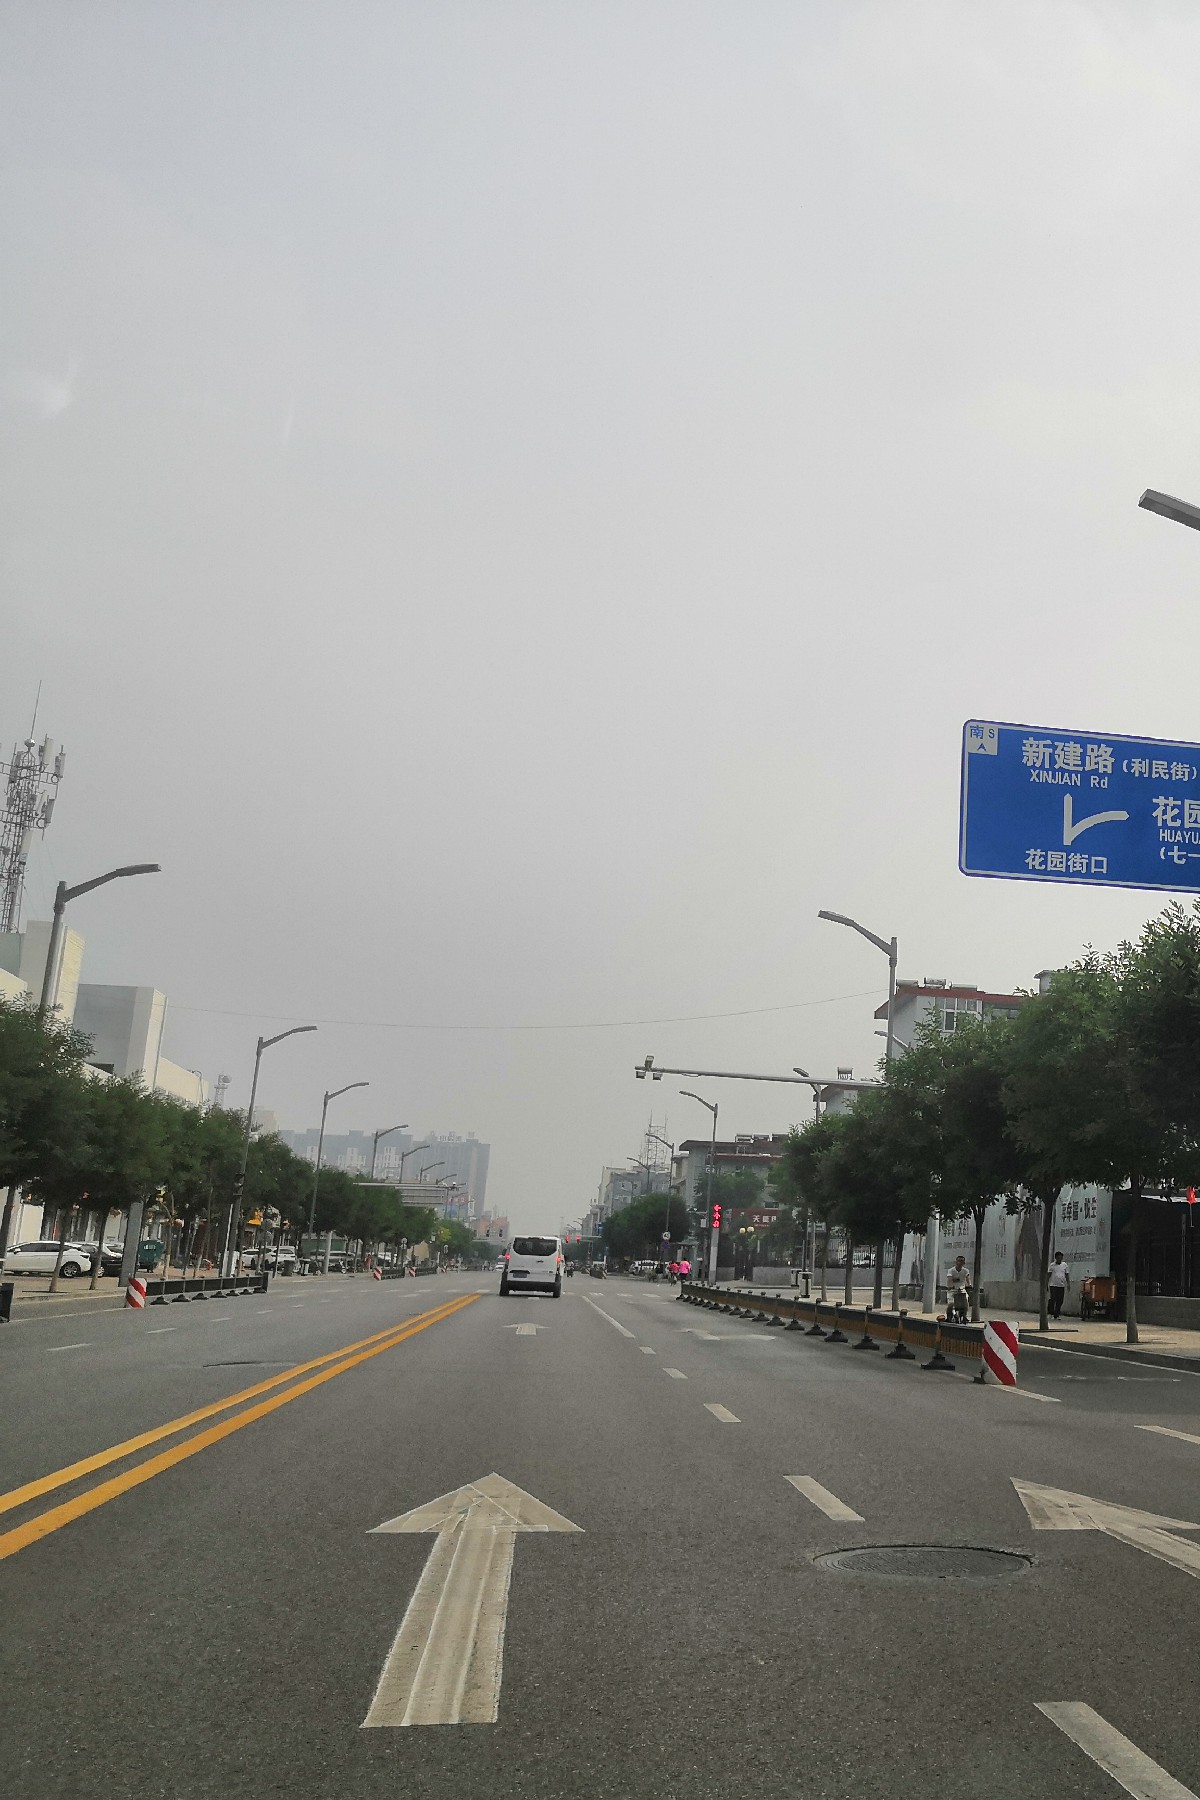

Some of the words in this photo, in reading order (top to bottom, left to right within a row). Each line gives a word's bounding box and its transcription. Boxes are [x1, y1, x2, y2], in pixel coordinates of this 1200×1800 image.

[970, 725, 984, 739] 南
[988, 728, 995, 739] S
[1021, 736, 1115, 774] 新建路
[1029, 769, 1081, 787] XINJIAN
[1091, 775, 1108, 789] Rd
[1024, 848, 1108, 874] 花园街口
